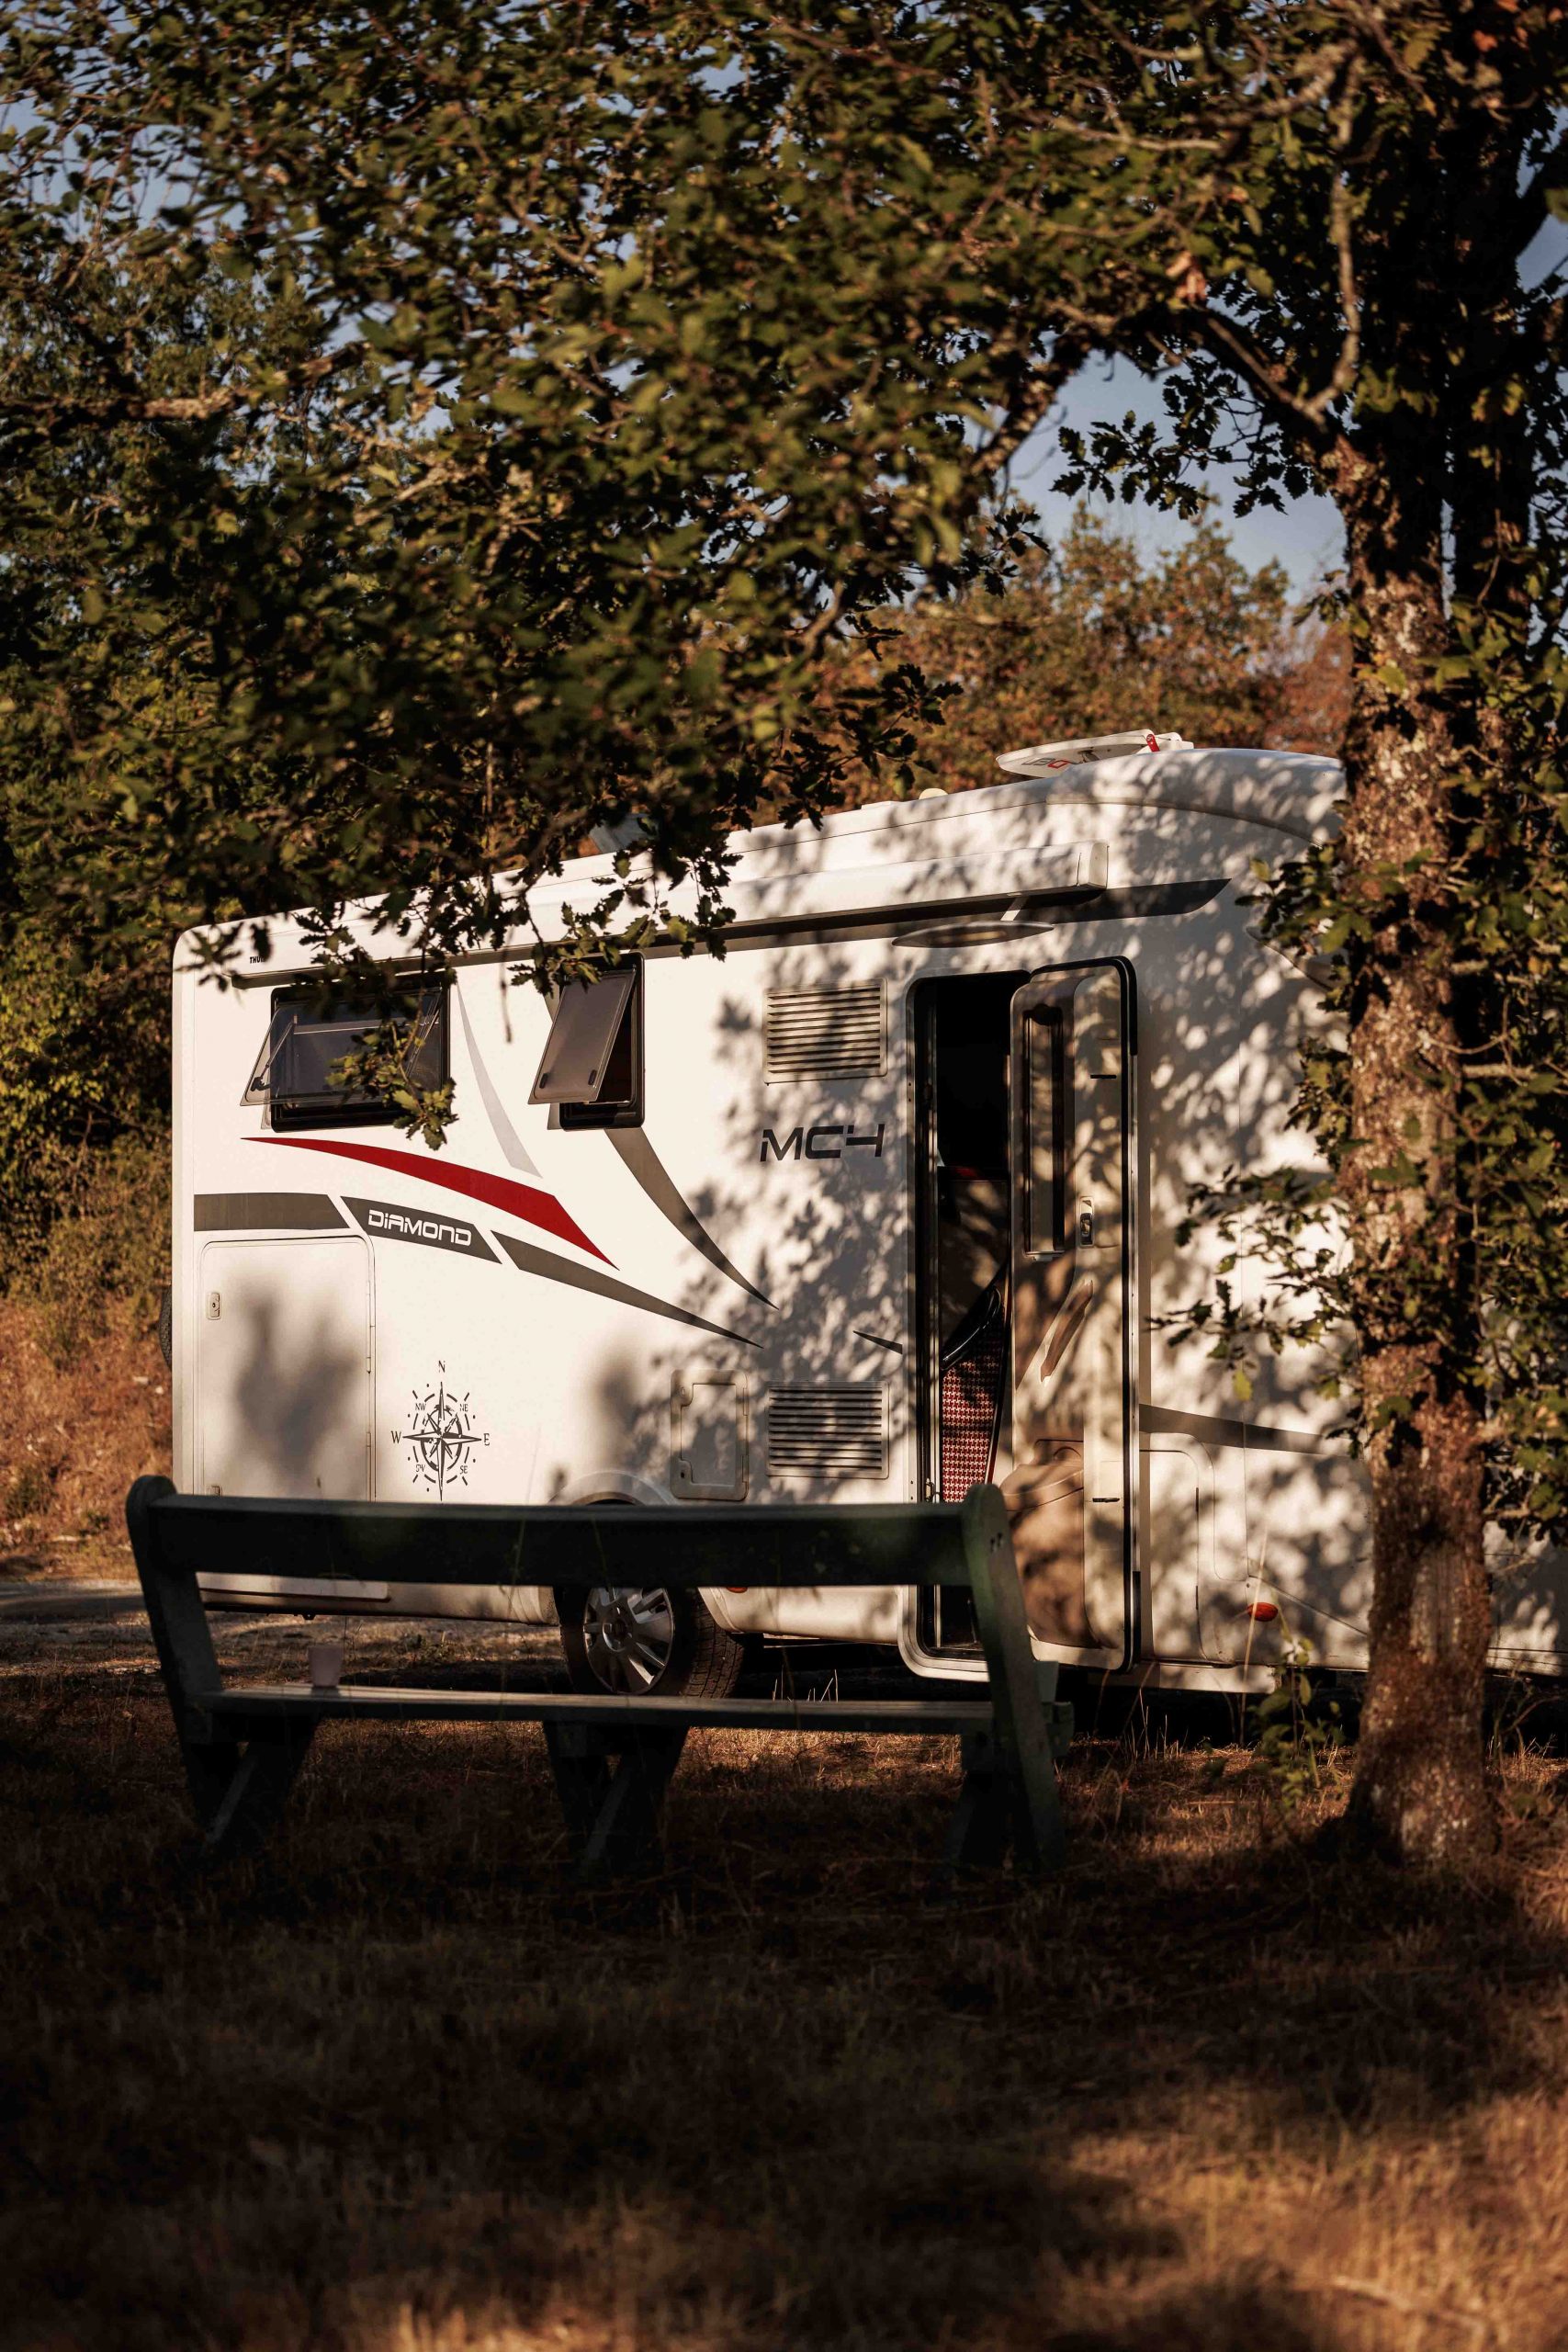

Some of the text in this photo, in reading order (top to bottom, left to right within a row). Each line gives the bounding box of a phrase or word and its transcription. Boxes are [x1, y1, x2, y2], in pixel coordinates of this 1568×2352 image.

[760, 1124, 886, 1162] MC4
[438, 1360, 446, 1373] N
[415, 1403, 426, 1411] NW
[460, 1404, 468, 1412] NE
[390, 1430, 401, 1444] W
[483, 1433, 491, 1446] E
[460, 1465, 468, 1475] SE
